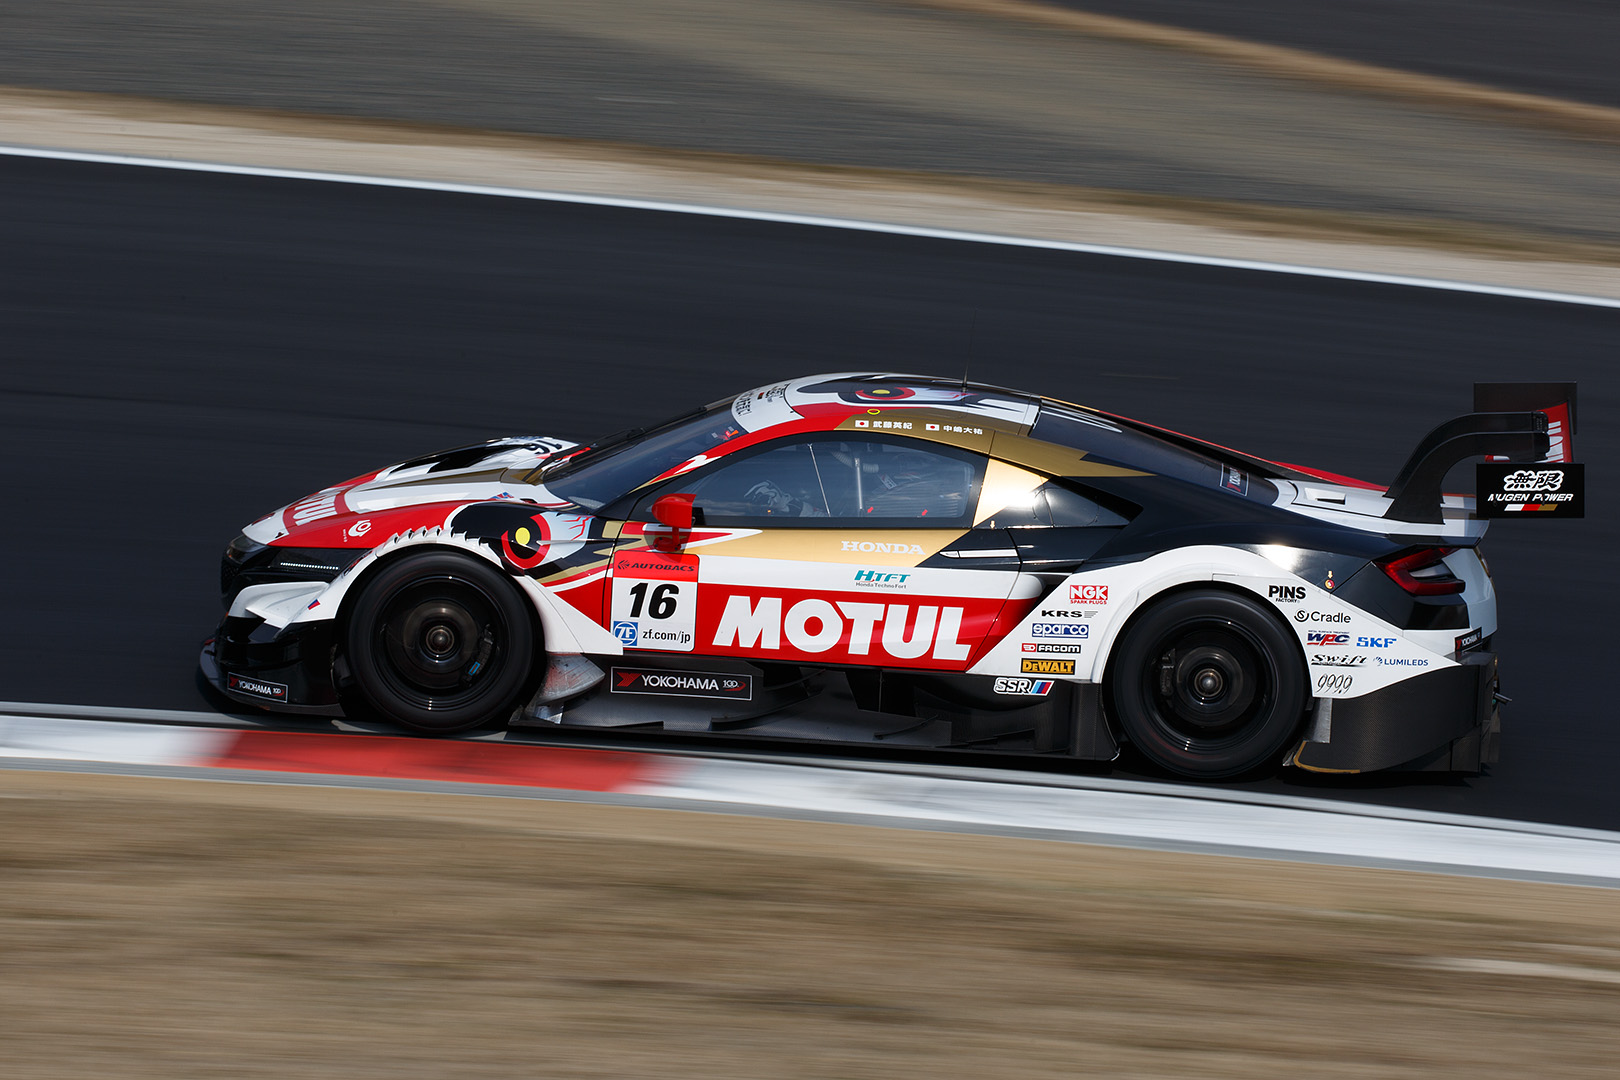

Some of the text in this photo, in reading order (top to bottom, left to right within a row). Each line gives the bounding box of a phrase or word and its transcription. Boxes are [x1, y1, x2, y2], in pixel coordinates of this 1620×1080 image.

[1503, 470, 1565, 491] 無限
[841, 540, 926, 555] HONDA
[631, 562, 695, 572] AUTOBACS
[854, 569, 911, 583] HTFT
[1070, 585, 1108, 600] NGK
[1268, 585, 1306, 600] PINS
[629, 582, 680, 620] 16
[1041, 610, 1083, 618] KRS
[1310, 611, 1352, 623] Cradle
[712, 595, 972, 661] MOTUL
[1032, 624, 1088, 637] sparco
[642, 629, 691, 644] zf.com/jp
[1307, 633, 1350, 645] WPC
[1356, 636, 1397, 648] SKF
[1038, 645, 1081, 653] FACOM
[1310, 654, 1368, 666] Swift
[1384, 658, 1429, 667] LUMILEDS
[238, 680, 272, 695] YOKOHAMA
[641, 674, 720, 691] YOKOHAMA
[994, 679, 1031, 694] SSR
